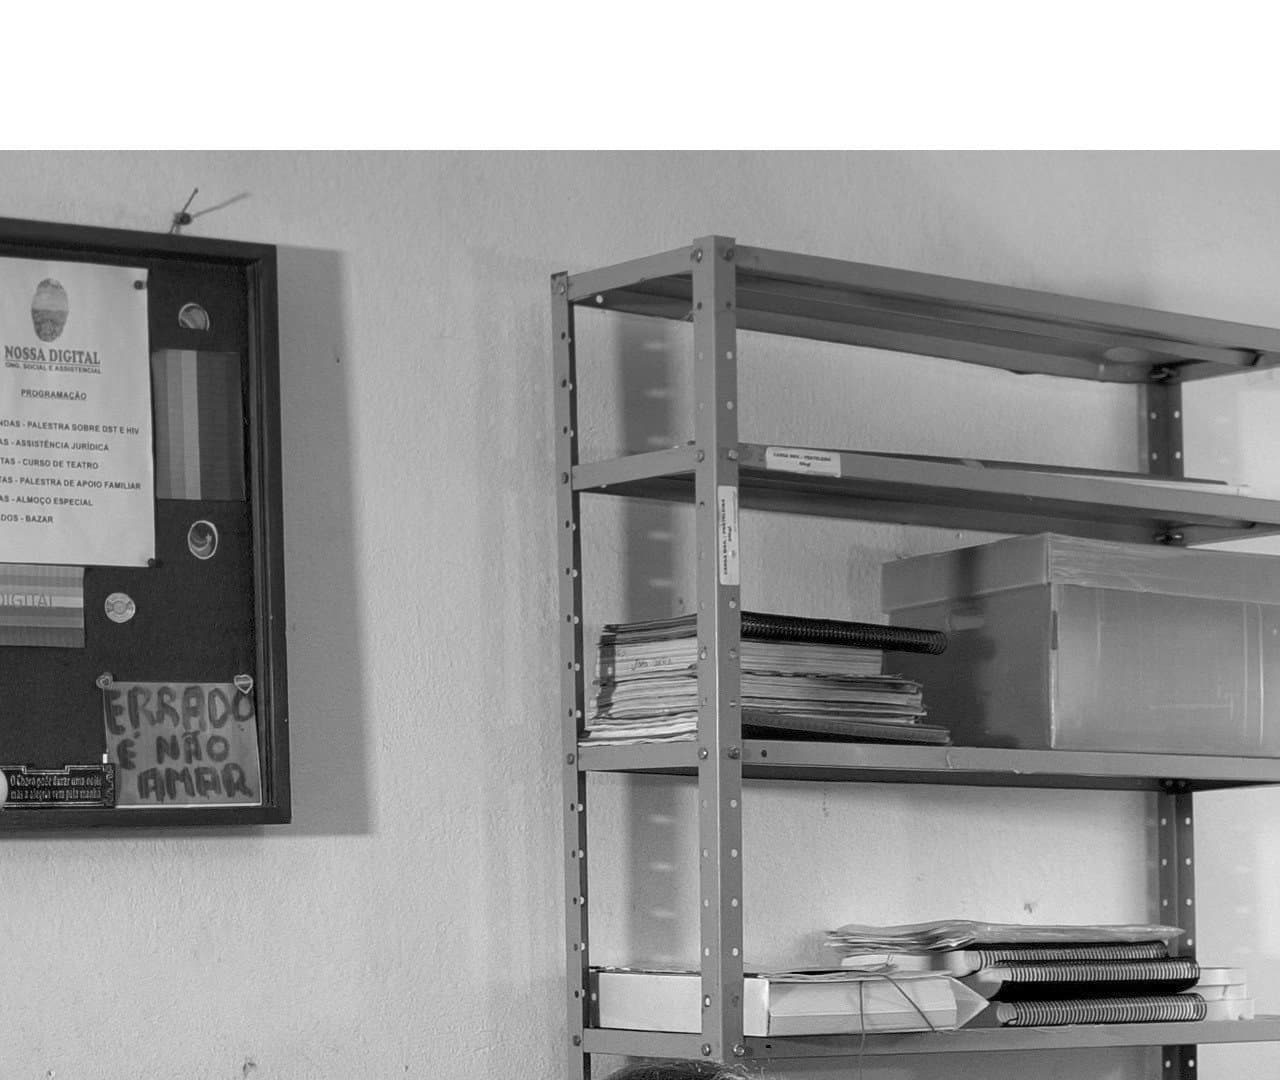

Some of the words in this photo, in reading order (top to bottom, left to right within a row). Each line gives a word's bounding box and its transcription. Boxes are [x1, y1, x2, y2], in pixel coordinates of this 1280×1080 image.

[4, 345, 46, 361] NOSSA
[49, 350, 101, 365] DIGITAL
[55, 366, 102, 374] ASSISTENCIAL
[20, 388, 87, 400] PROGRAMAÇÃO
[27, 421, 70, 431] PALESTRA
[72, 424, 100, 432] SOBRE
[102, 425, 118, 434] DST
[120, 426, 124, 434] E
[126, 426, 139, 435] HIV
[16, 439, 70, 449] ASSISTÊNCIA
[70, 441, 108, 451] JURÍDICA
[22, 458, 51, 468] CURSO
[53, 460, 64, 468] DE
[66, 460, 99, 470] TEATRO
[20, 477, 62, 486] PALESTRA
[76, 480, 102, 488] APOIO
[104, 481, 142, 490] FAMILIAR
[16, 496, 52, 505] ALMOÇO
[53, 497, 93, 506] ESPECIAL
[25, 514, 54, 523] BAZAR
[104, 685, 256, 735] ERRADO
[117, 730, 140, 770] É
[156, 730, 230, 764] NÃO
[136, 762, 254, 802] AMAR
